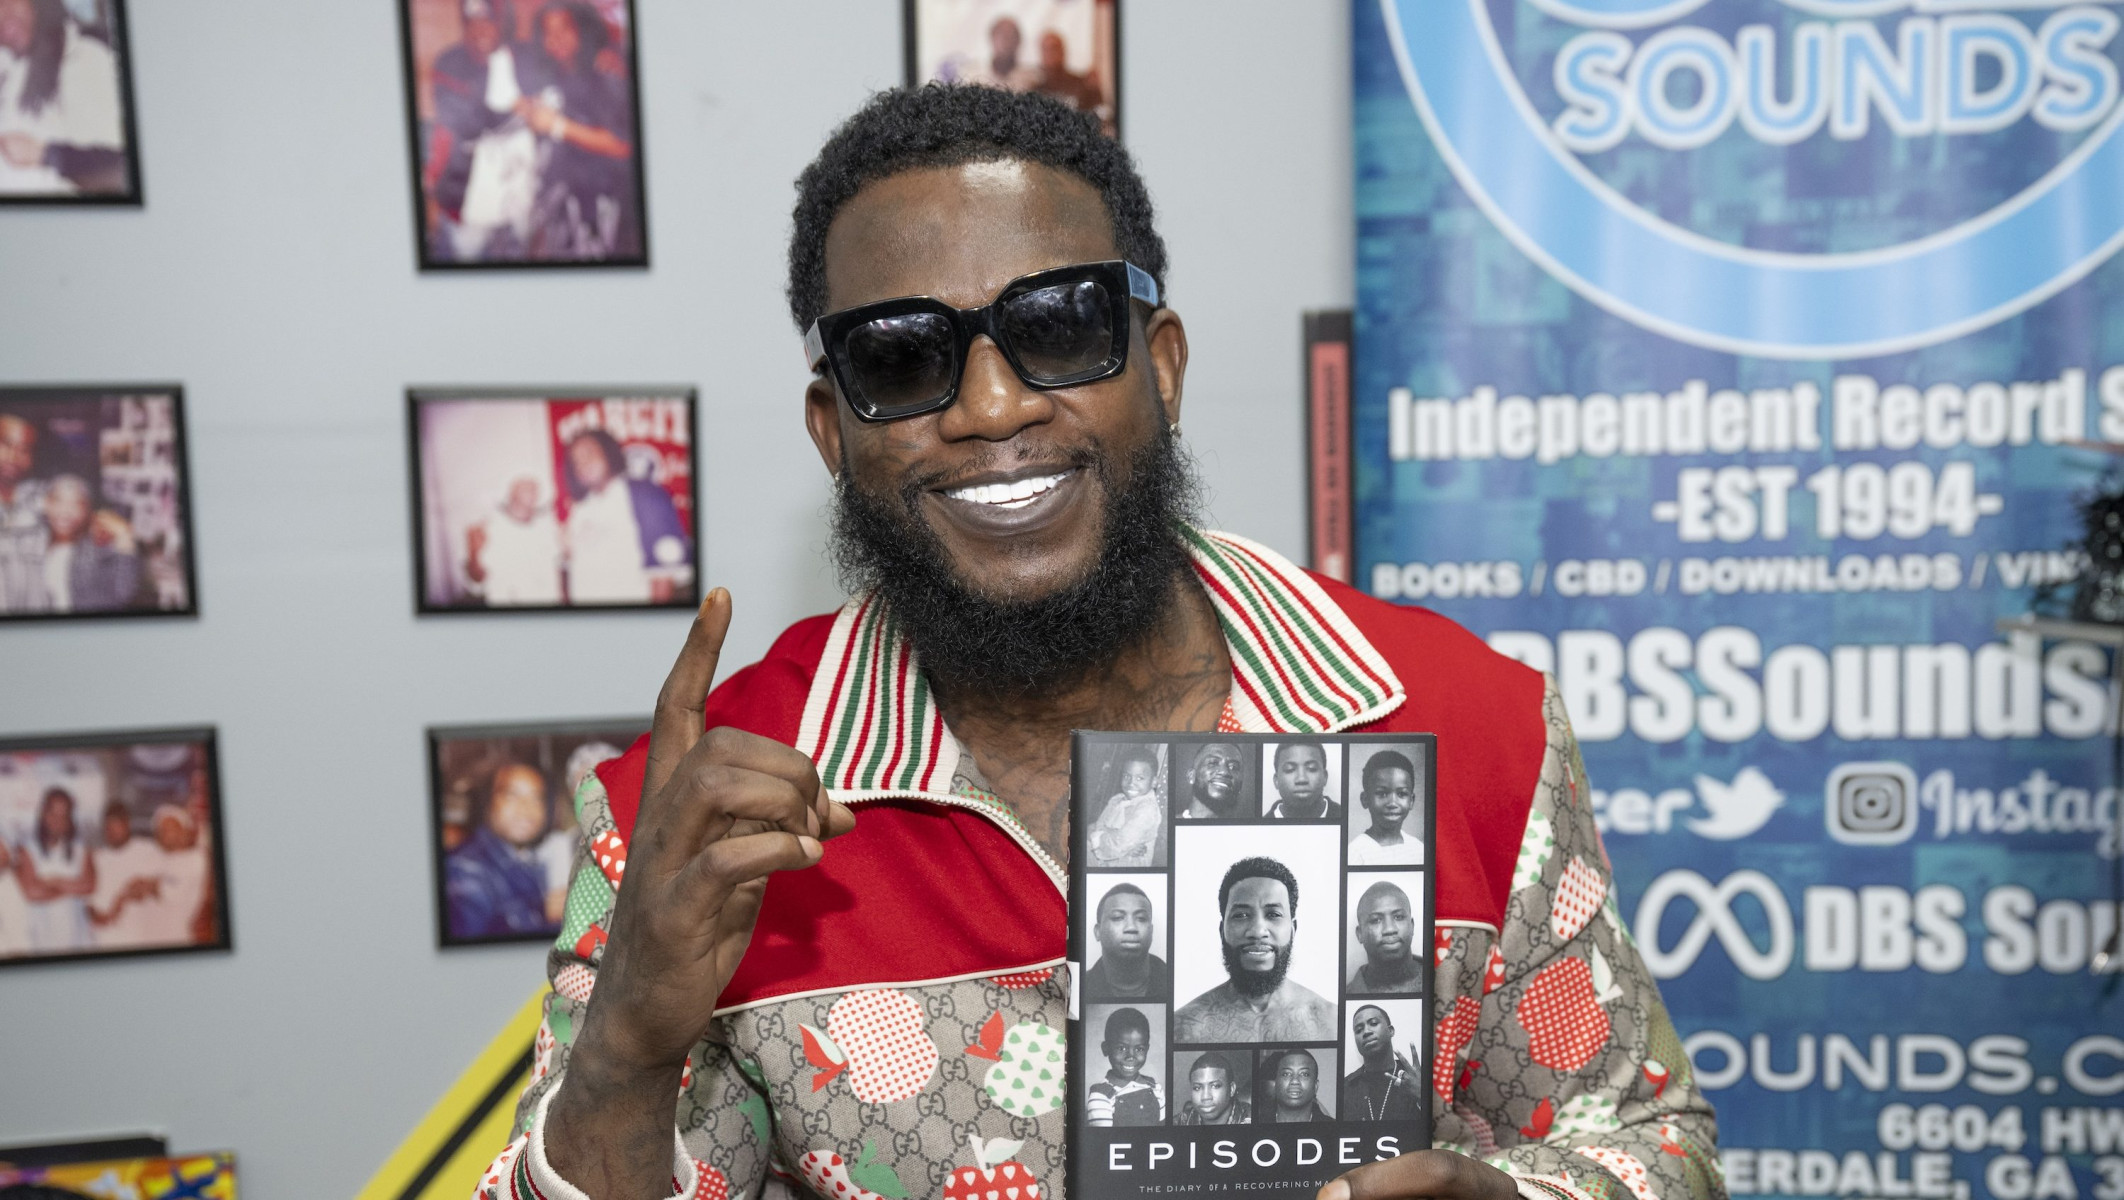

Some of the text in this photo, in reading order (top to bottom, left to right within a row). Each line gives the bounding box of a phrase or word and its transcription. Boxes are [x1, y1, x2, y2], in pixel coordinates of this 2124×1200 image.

[1554, 5, 2120, 152] SOUNDS
[1388, 380, 1821, 465] Independent
[1832, 369, 2086, 452] Record
[1652, 462, 2003, 543] -EST 1994-
[1372, 561, 1523, 599] BOOKS
[1554, 558, 1647, 597] CBD
[1679, 552, 1962, 595] DOWNLOADS
[1997, 550, 2086, 589] VIN
[1488, 616, 2119, 743] BSSounds
[1803, 885, 1968, 974] DBS
[1109, 1136, 1401, 1171] EPISODES
[1878, 1103, 2027, 1152] 6604
[1139, 1185, 1161, 1193] THE
[1166, 1184, 1202, 1193] DIARY
[1208, 1183, 1219, 1192] OF
[1235, 1180, 1310, 1191] RECOVERING
[1985, 1154, 2078, 1200] GA
